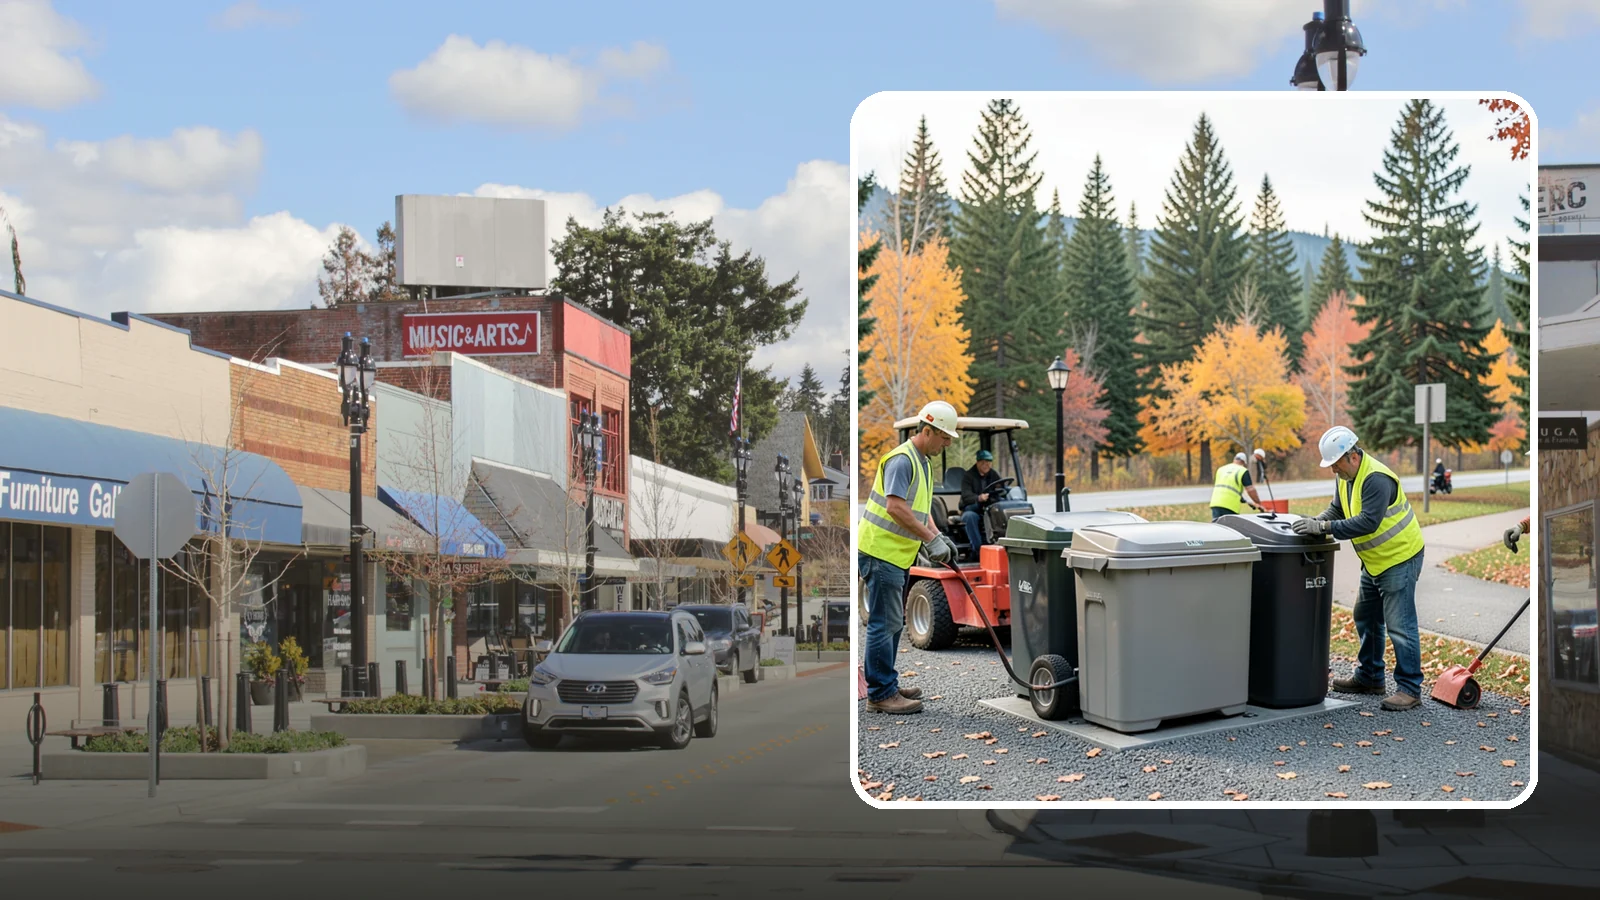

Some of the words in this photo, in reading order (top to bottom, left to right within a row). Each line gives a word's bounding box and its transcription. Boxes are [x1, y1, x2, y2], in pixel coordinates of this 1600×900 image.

[409, 323, 520, 349] MUSIC&ARTS
[1540, 427, 1578, 437] UGA
[0, 471, 80, 516] Furniture
[453, 563, 480, 574] SUSHI
